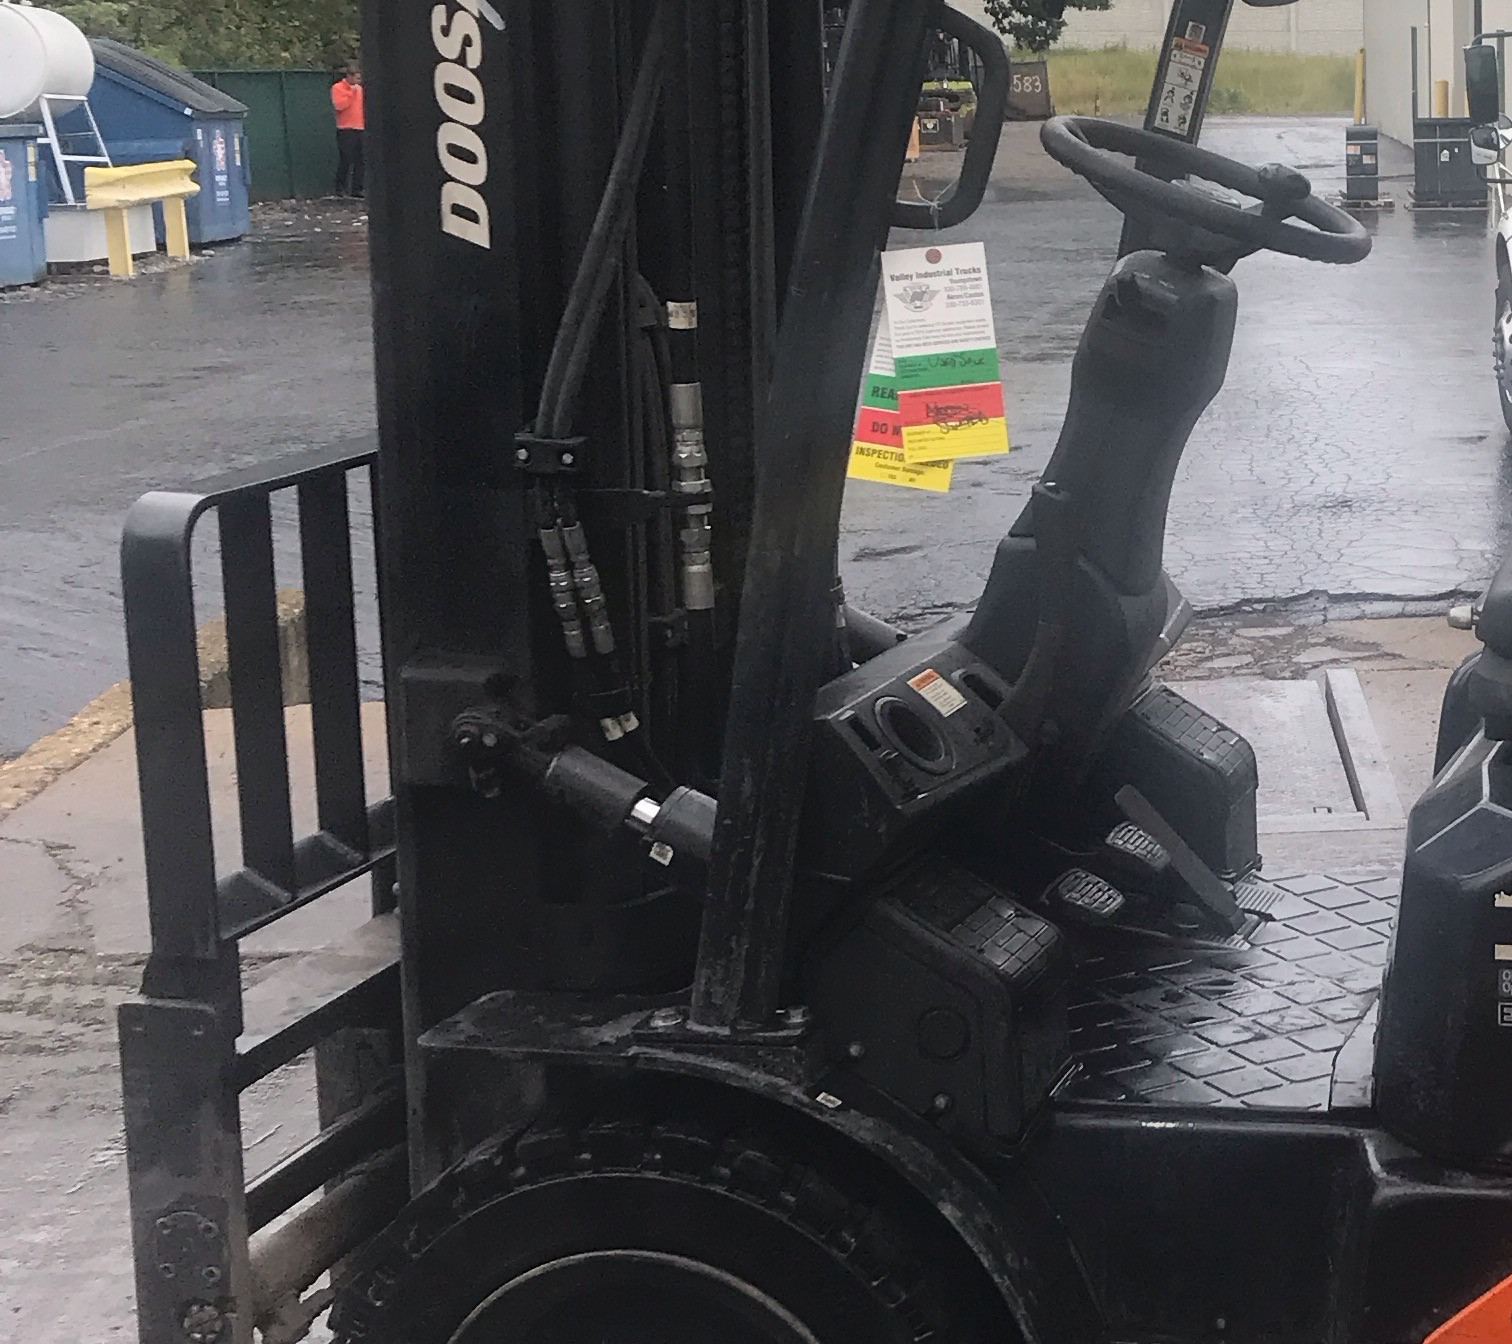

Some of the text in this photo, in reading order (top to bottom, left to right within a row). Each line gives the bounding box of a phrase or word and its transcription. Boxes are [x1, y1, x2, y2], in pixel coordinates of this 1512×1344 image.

[889, 266, 982, 282] Valley Industrial Trucks
[871, 386, 898, 400] REA
[855, 445, 906, 462] INSPECTIO
